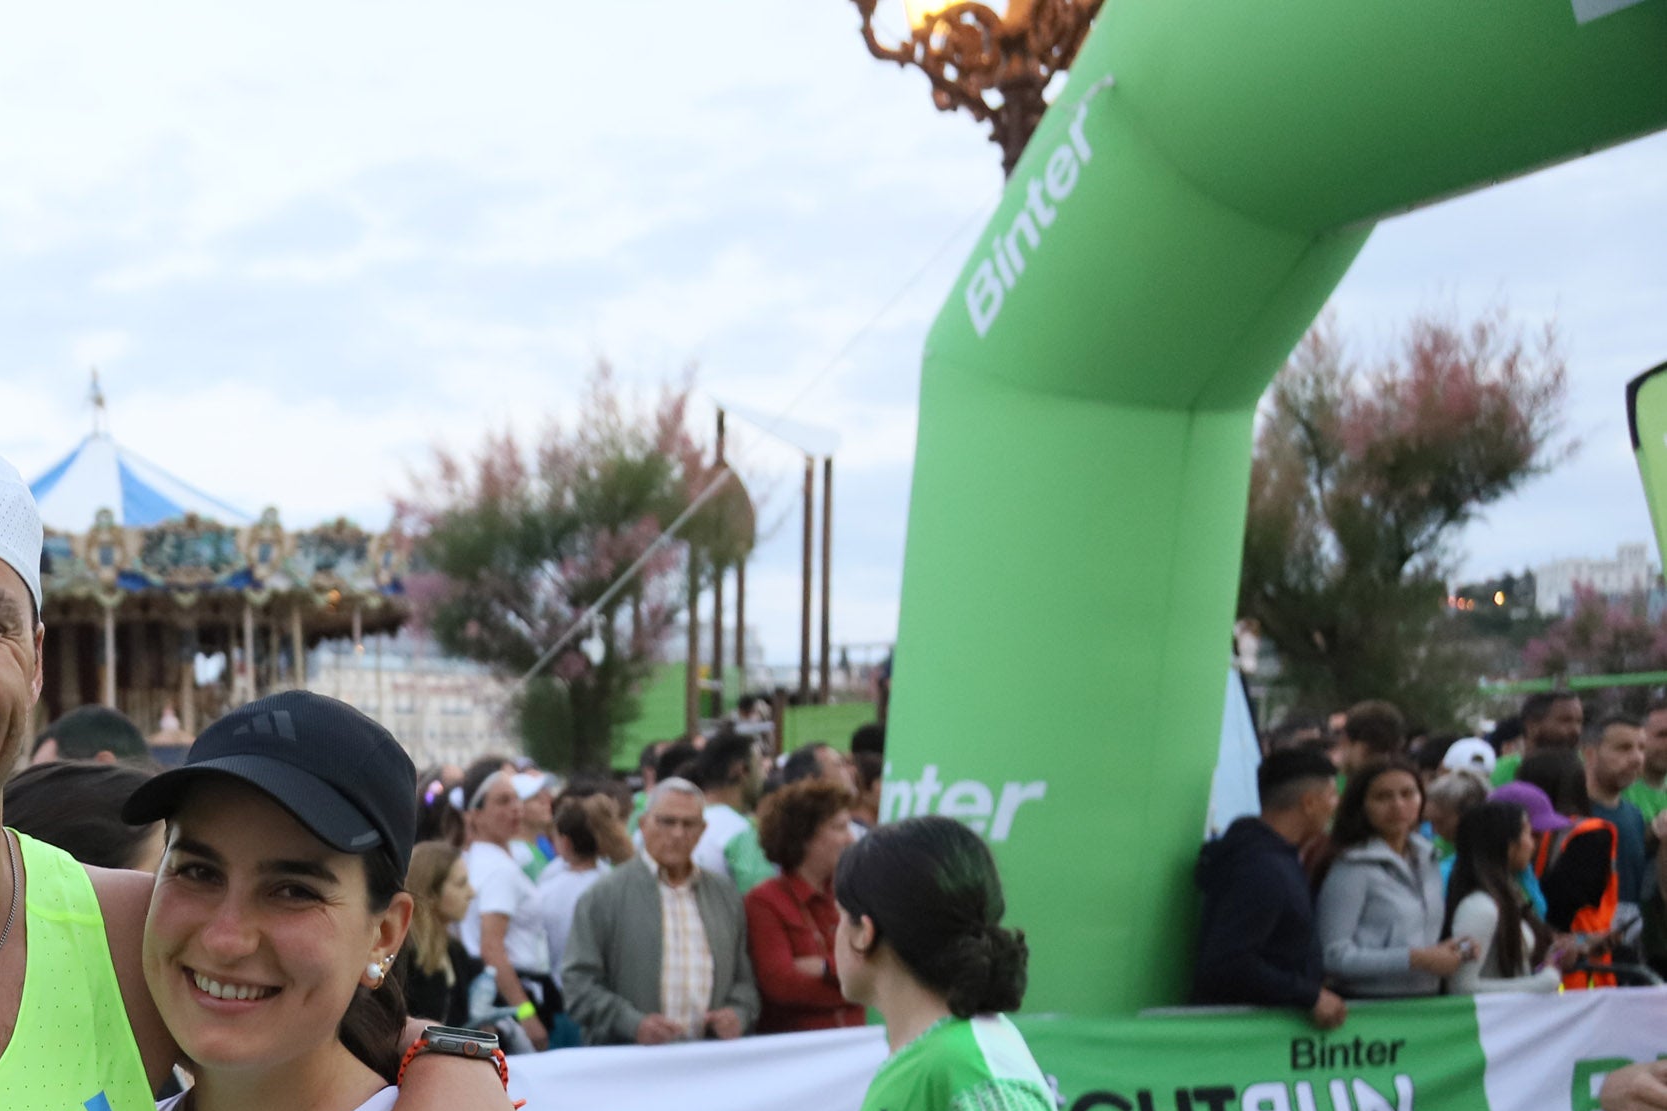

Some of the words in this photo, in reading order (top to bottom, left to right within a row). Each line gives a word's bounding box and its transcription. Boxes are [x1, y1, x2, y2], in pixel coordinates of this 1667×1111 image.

[965, 103, 1092, 338] Binter
[878, 761, 1048, 841] inter
[1289, 1037, 1406, 1071] Binter
